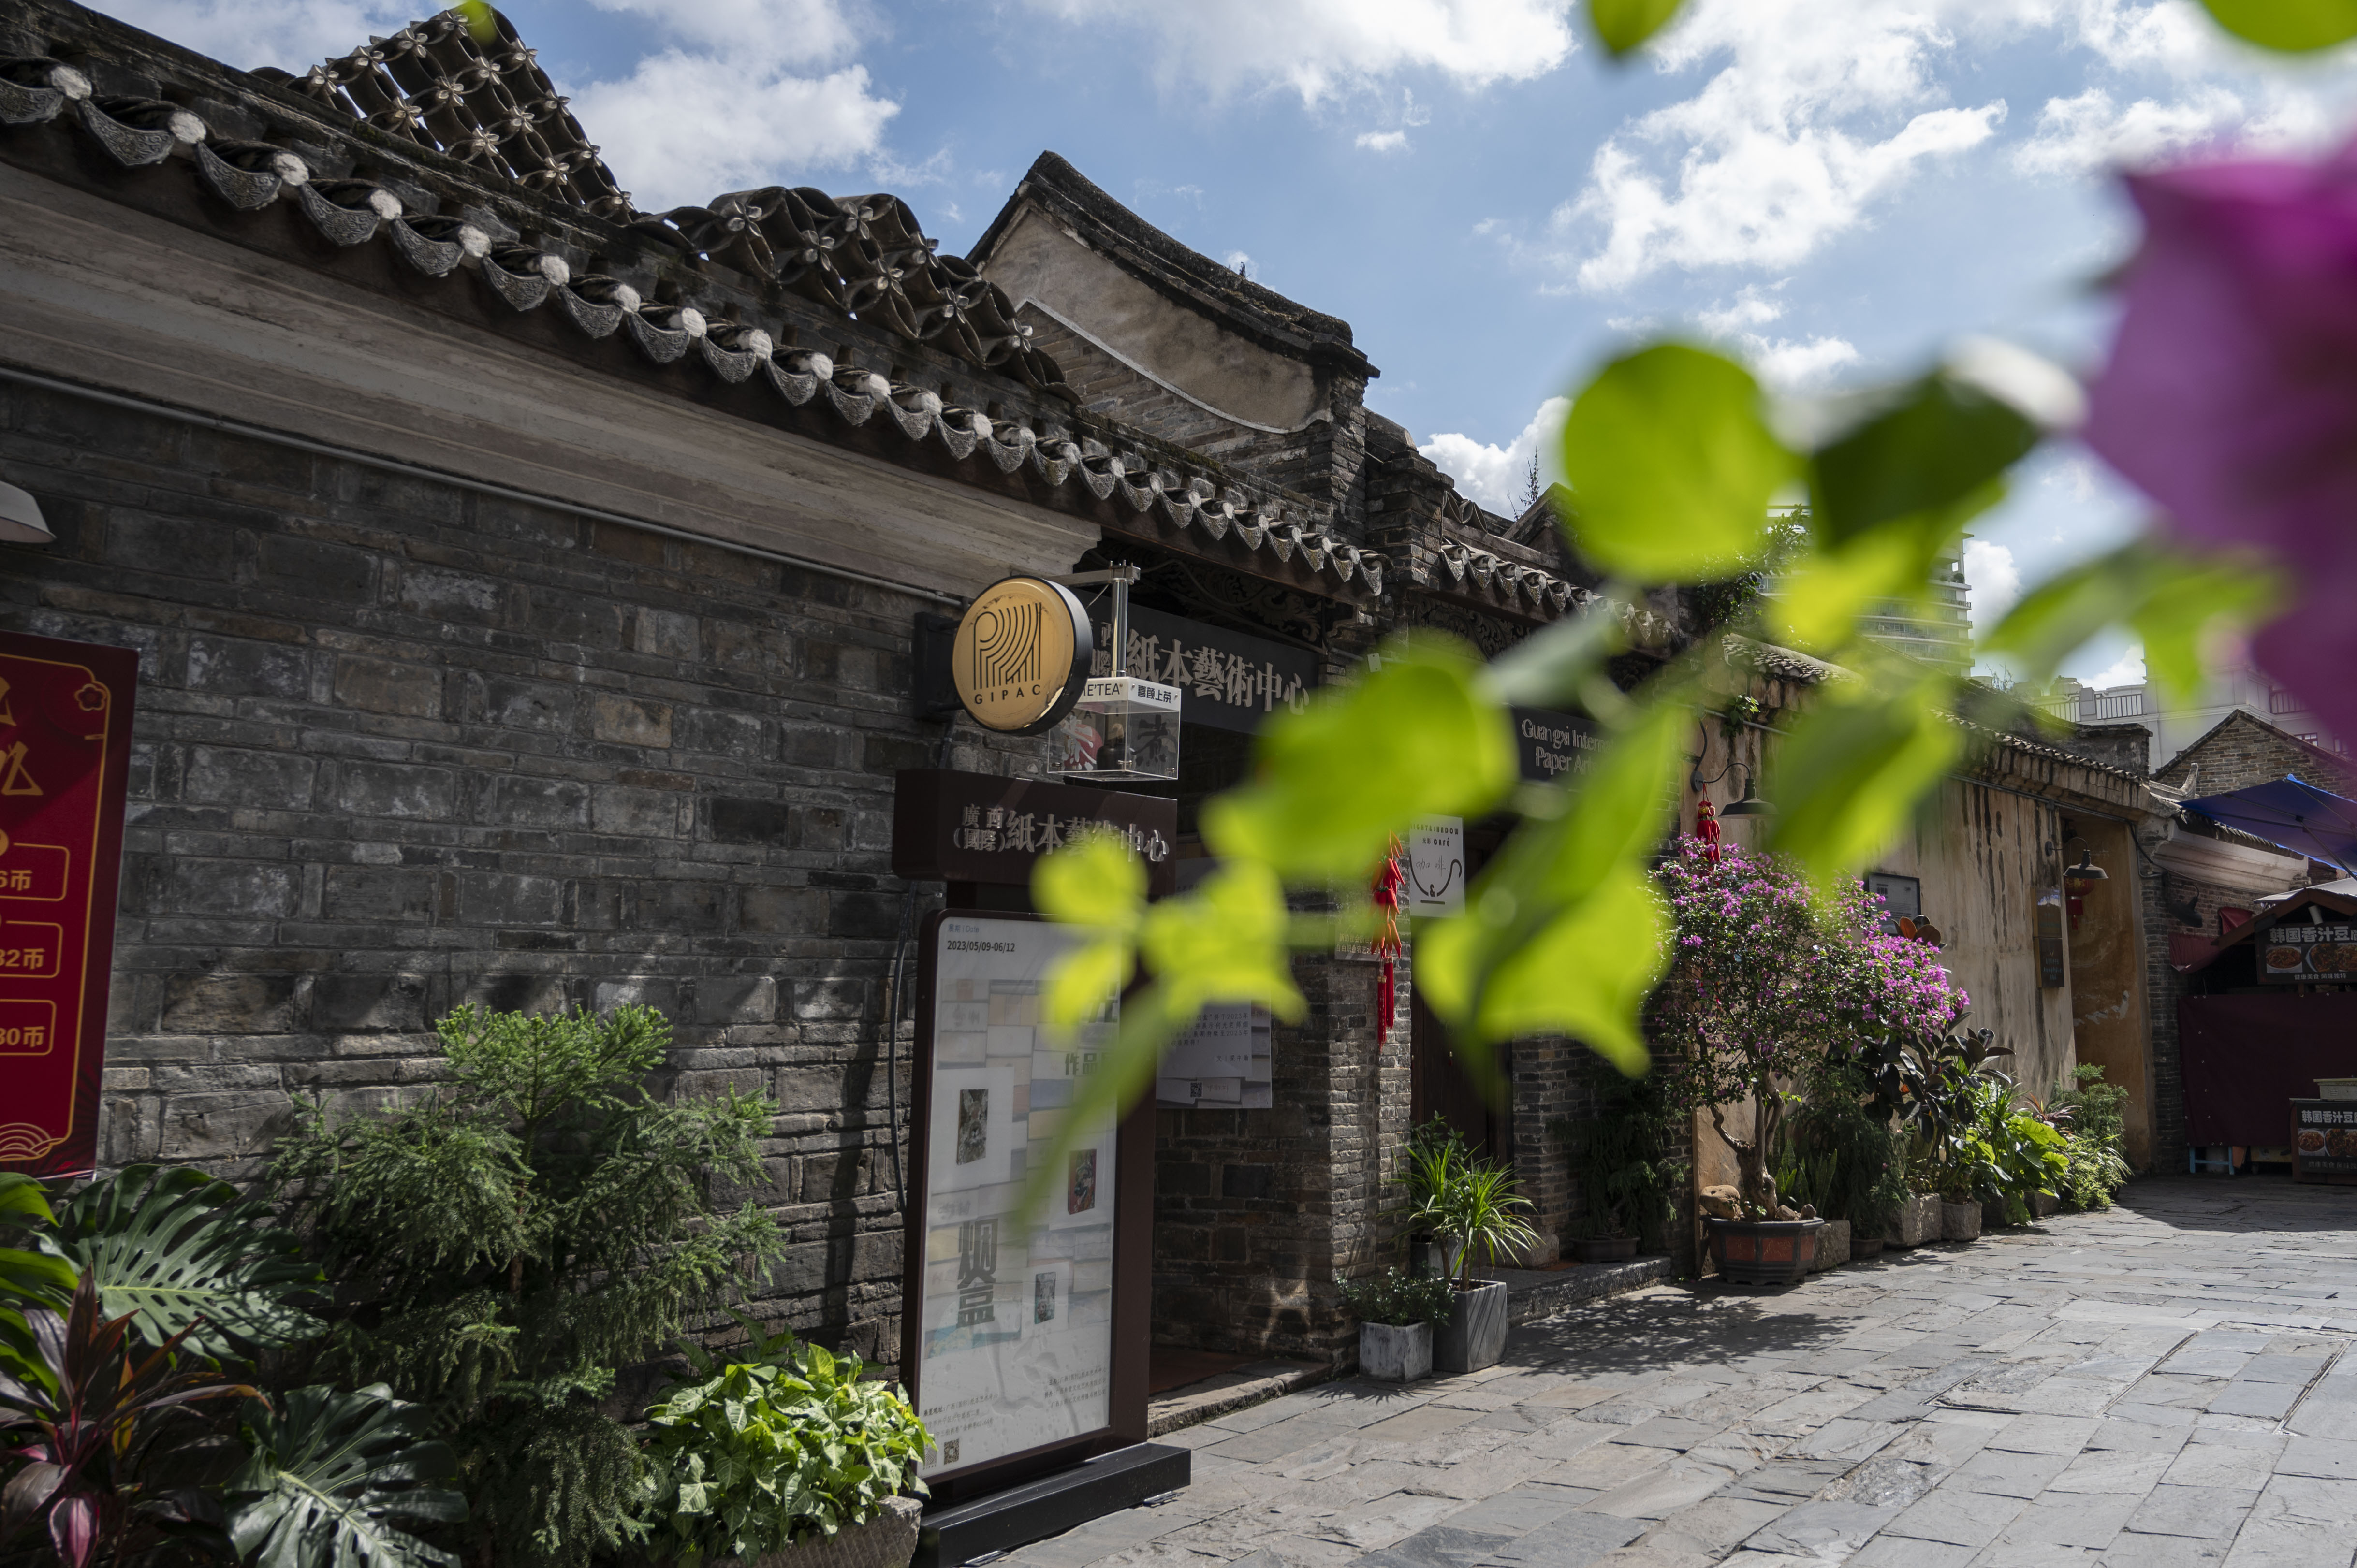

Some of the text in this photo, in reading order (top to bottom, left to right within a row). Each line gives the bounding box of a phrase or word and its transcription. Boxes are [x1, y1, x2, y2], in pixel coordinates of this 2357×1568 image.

[1127, 628, 1309, 716] 紙本藝術中心
[975, 684, 1040, 704] GIPAC
[1083, 683, 1120, 697] E'TEA
[1138, 684, 1171, 704] 喜颜上茶
[1536, 746, 1572, 775] Paper
[962, 804, 1004, 828] 廣西
[947, 940, 1016, 954] 2023/05/09-06/12
[957, 1218, 998, 1329] 烟盒
